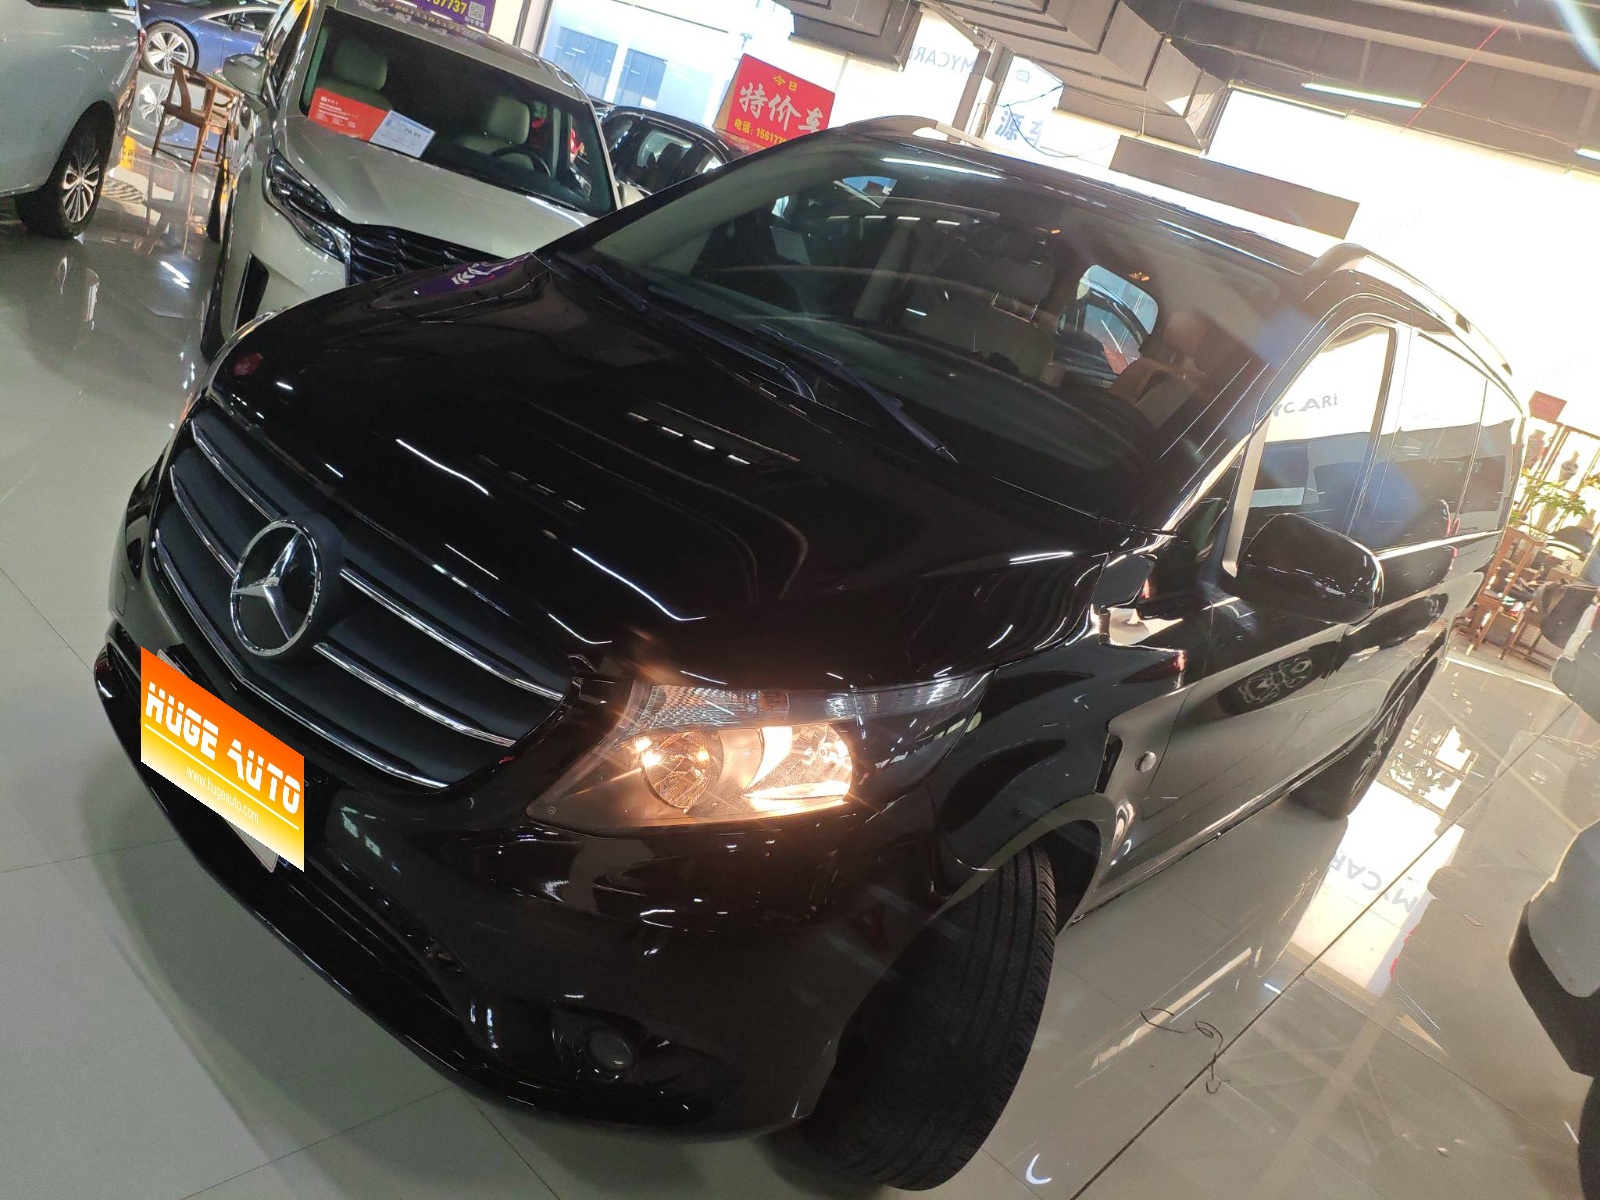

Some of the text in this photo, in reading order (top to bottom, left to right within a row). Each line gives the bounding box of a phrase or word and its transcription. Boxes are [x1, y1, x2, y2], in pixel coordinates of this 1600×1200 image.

[772, 75, 798, 92] 今日
[739, 82, 824, 133] 特价车
